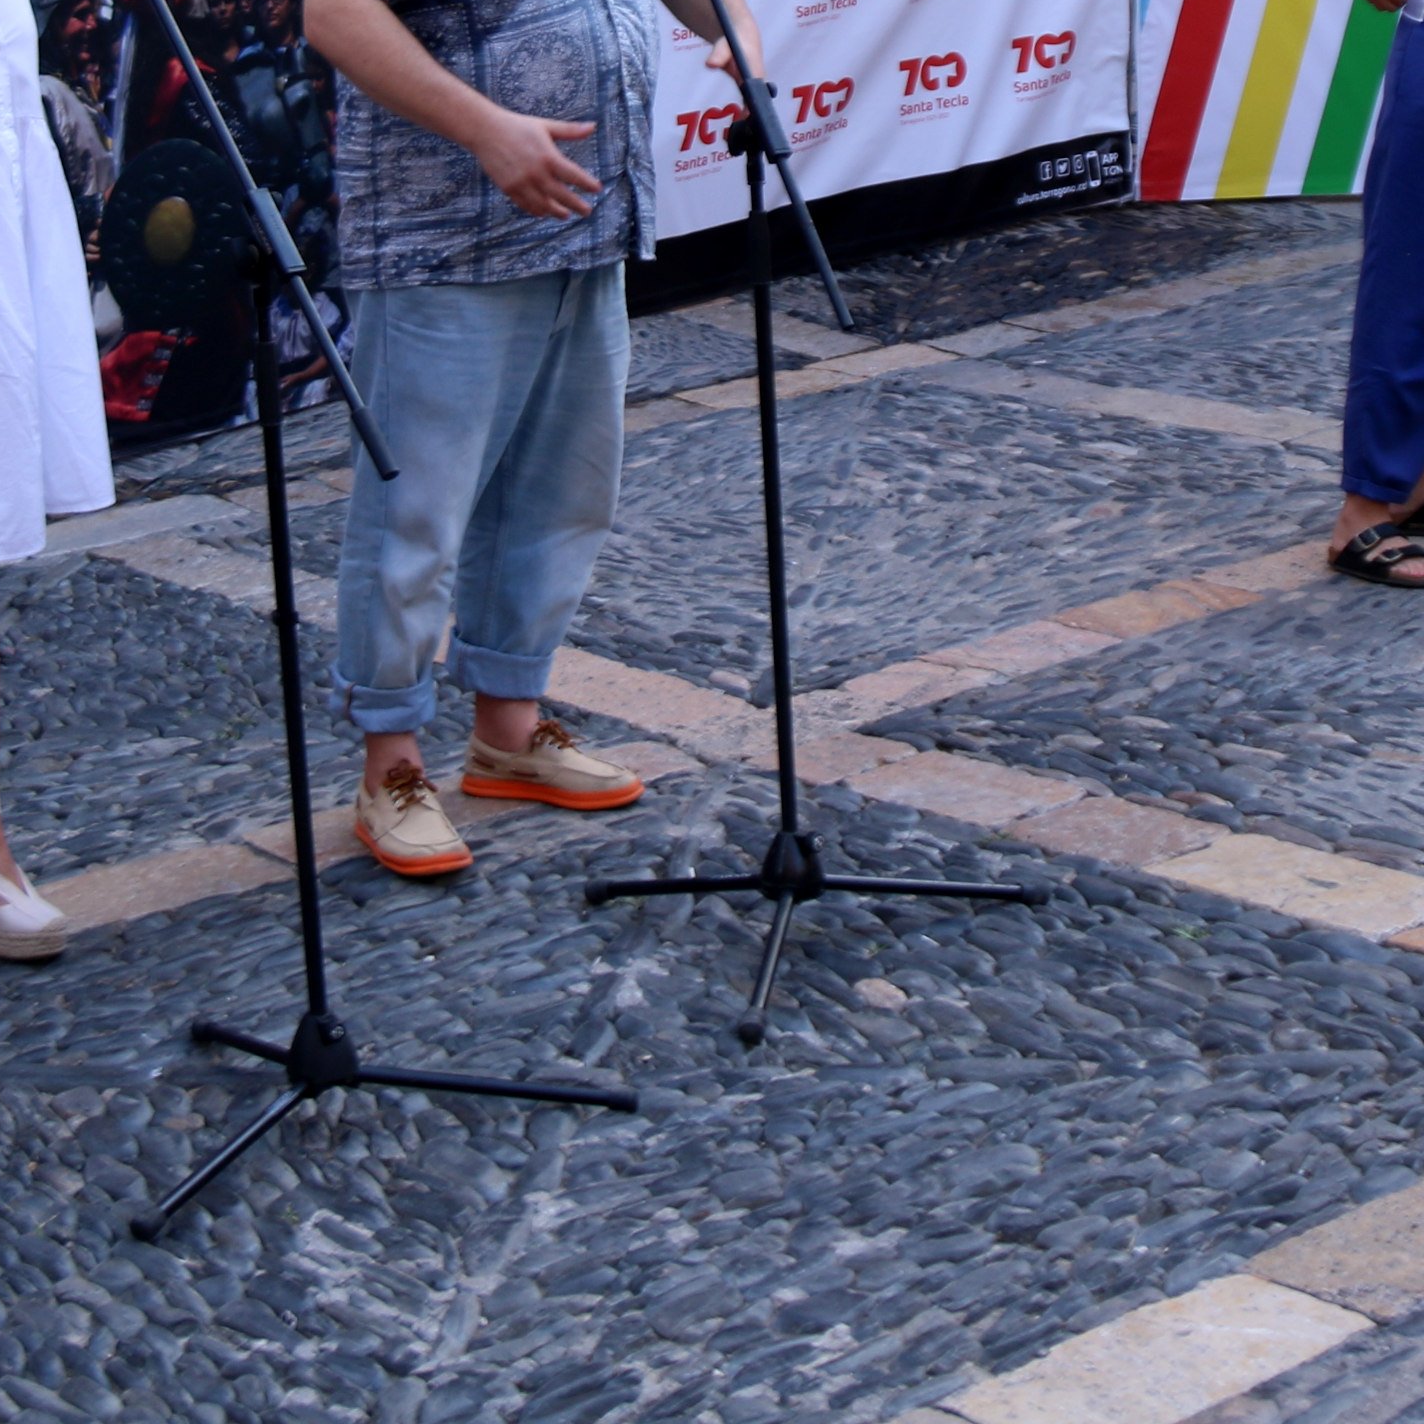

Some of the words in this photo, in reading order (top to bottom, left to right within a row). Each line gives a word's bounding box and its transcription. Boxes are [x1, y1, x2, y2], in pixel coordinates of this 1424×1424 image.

[795, 2, 827, 19] Santa
[1013, 78, 1049, 94] Santa
[1050, 68, 1072, 84] Tecla
[899, 100, 933, 117] Santa
[935, 93, 970, 109] Tecla
[791, 127, 823, 144] Santa
[824, 117, 848, 133] Tecla
[675, 155, 708, 173] Santa
